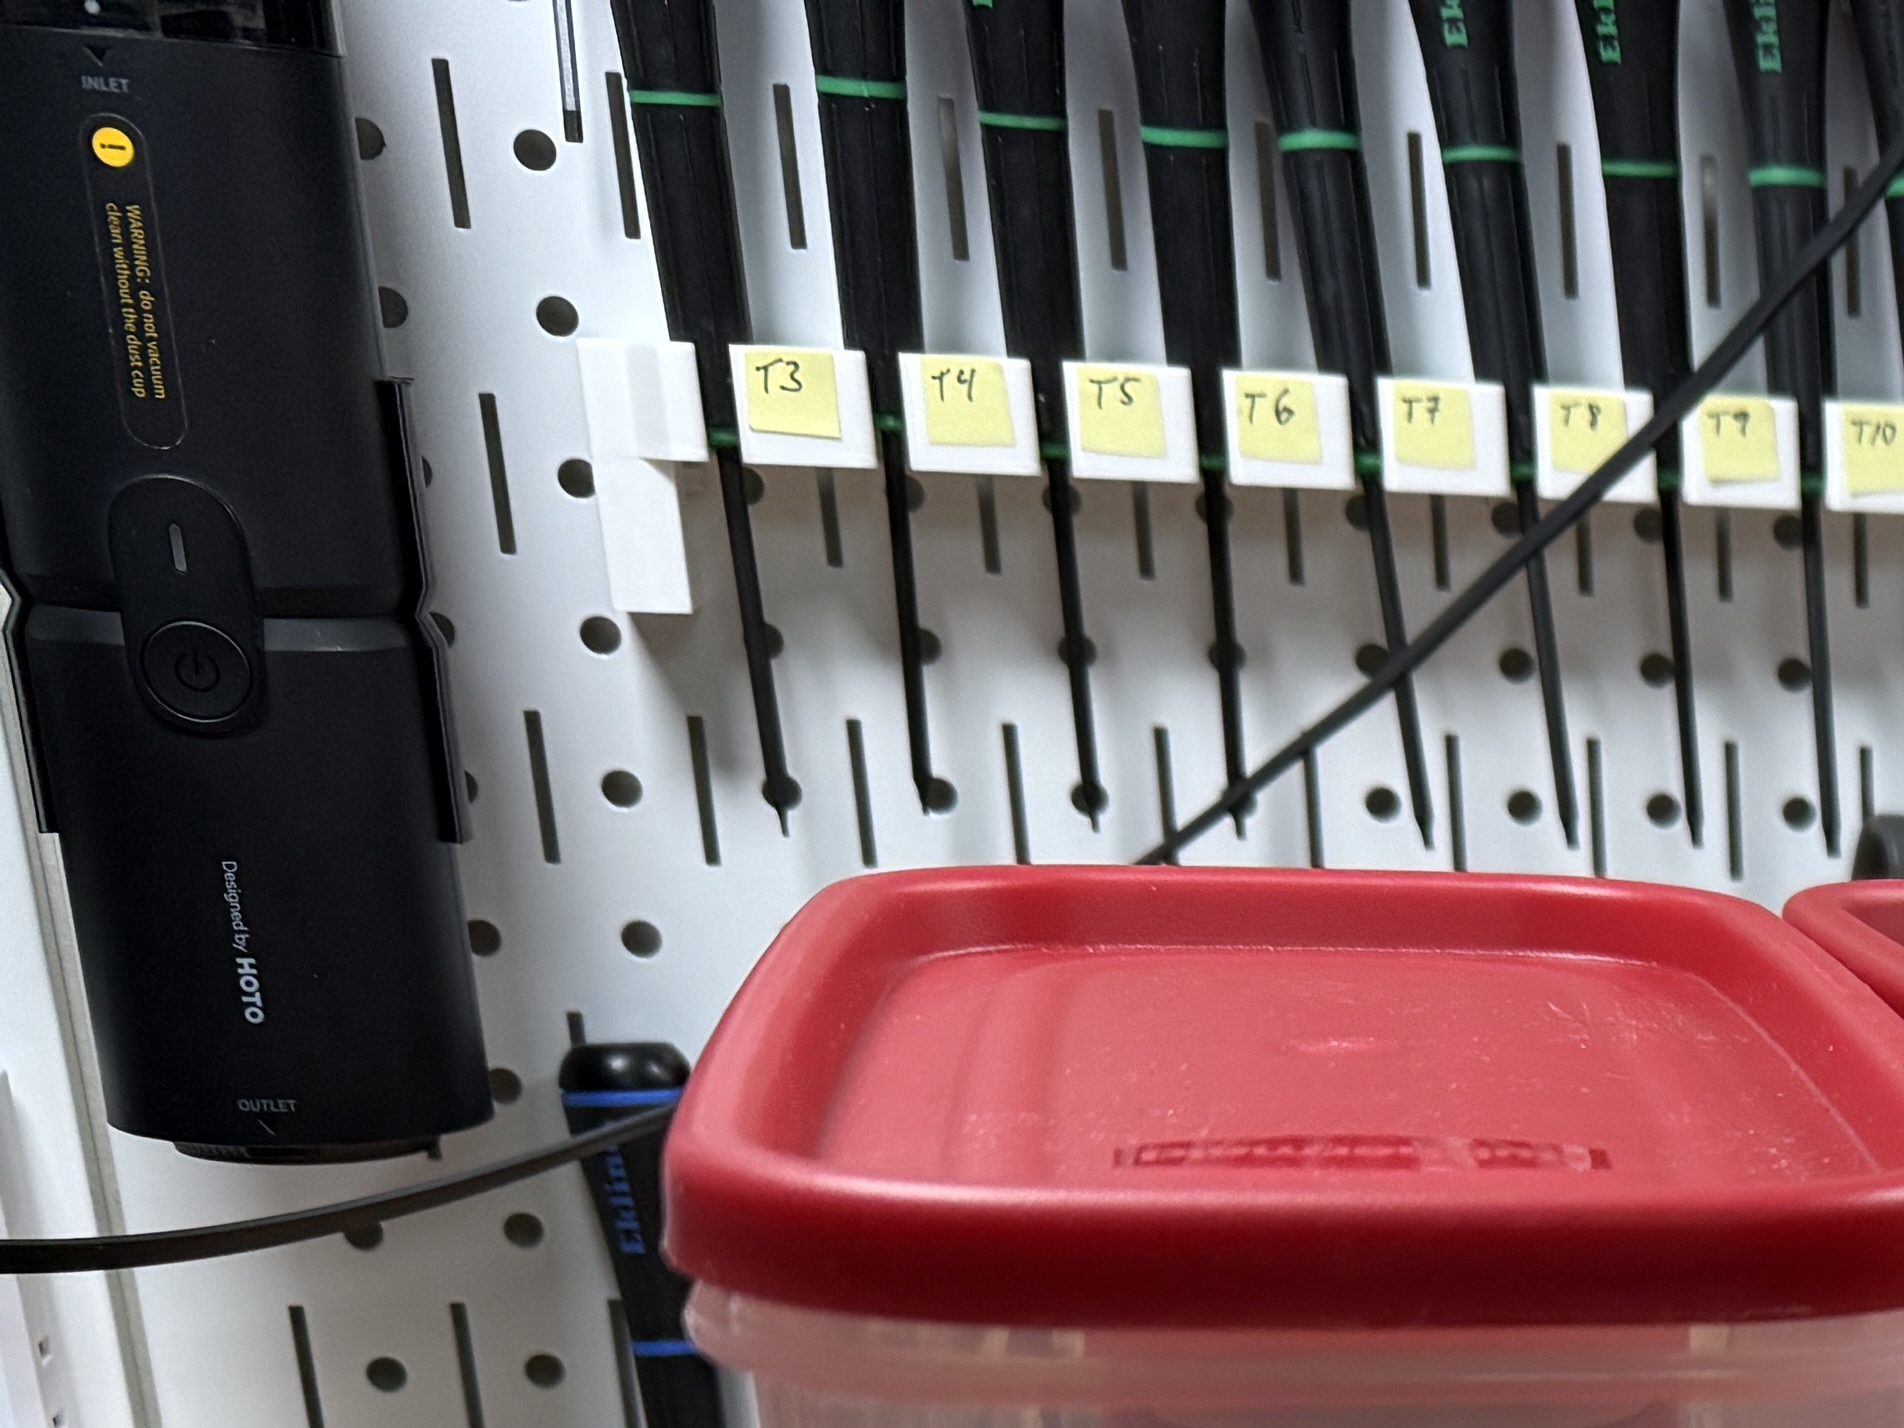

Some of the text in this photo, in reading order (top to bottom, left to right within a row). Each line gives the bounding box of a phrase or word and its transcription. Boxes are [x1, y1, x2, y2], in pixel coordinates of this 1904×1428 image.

[81, 75, 130, 93] INLET
[105, 203, 147, 398] clean without the dust cup
[125, 204, 166, 399] WARNING: do not vacuum
[755, 358, 803, 395] T3
[930, 367, 978, 402] T4
[1088, 376, 1143, 411] T5
[1244, 388, 1296, 427] T6
[1401, 394, 1441, 426] T7
[1851, 420, 1897, 447] T10
[221, 860, 265, 1025] Designed by HOTO
[237, 1098, 298, 1113] OUTLET
